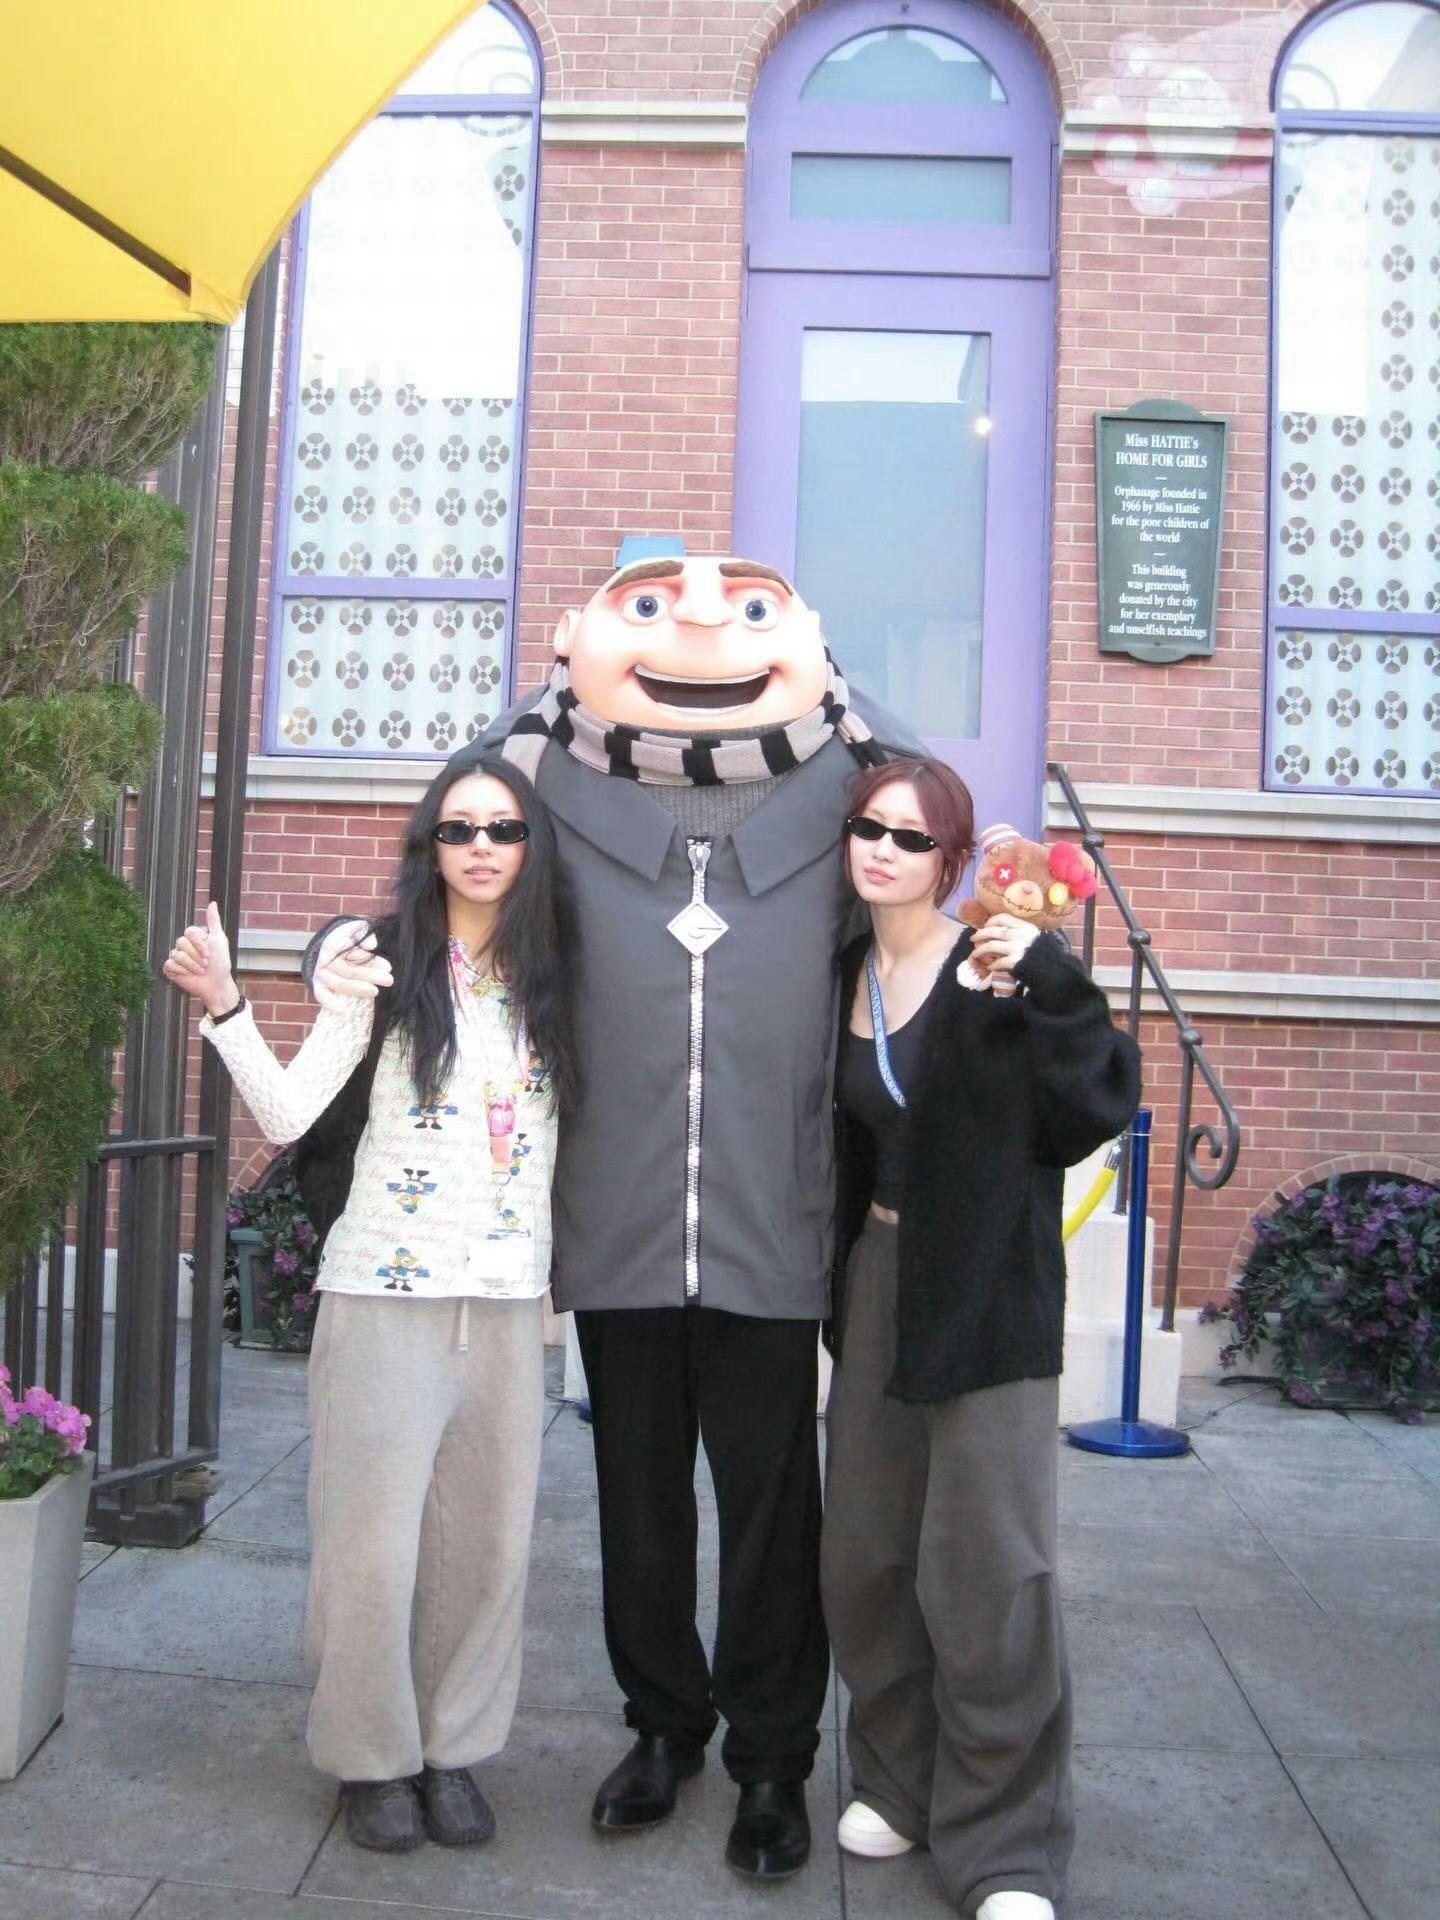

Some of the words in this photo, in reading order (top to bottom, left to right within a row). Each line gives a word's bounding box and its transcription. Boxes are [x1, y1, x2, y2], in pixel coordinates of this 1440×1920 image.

[1125, 433, 1149, 448] Miss
[1151, 434, 1199, 449] HATTIE's
[1115, 451, 1149, 466] HOME
[1152, 453, 1174, 467] FOR
[1176, 454, 1207, 468] GIRLS
[1114, 485, 1160, 500] Orphanage
[1162, 487, 1197, 499] founded
[1198, 489, 1207, 500] in
[1121, 500, 1140, 513] 1966
[1142, 501, 1153, 514] by
[1155, 502, 1173, 513] Miss
[1175, 503, 1200, 514] Hattie
[1111, 514, 1124, 526] for
[1126, 515, 1140, 526] the
[1141, 518, 1162, 529] poor
[1163, 516, 1198, 529] children
[1200, 518, 1211, 529] of
[1140, 531, 1154, 542] the
[1156, 532, 1180, 543] world
[1132, 563, 1150, 575] This
[1152, 564, 1187, 579] building
[1127, 581, 1143, 589] was
[1145, 580, 1191, 594] generously
[1119, 592, 1153, 605] donated
[1155, 595, 1165, 608] by
[1167, 595, 1180, 606] the
[1182, 596, 1198, 609] city
[1120, 608, 1133, 619] for
[1135, 608, 1150, 620] her
[1151, 610, 1196, 624] exemplary
[1109, 622, 1125, 633] and
[1126, 623, 1166, 635] unselfish
[1167, 625, 1207, 640] teachings
